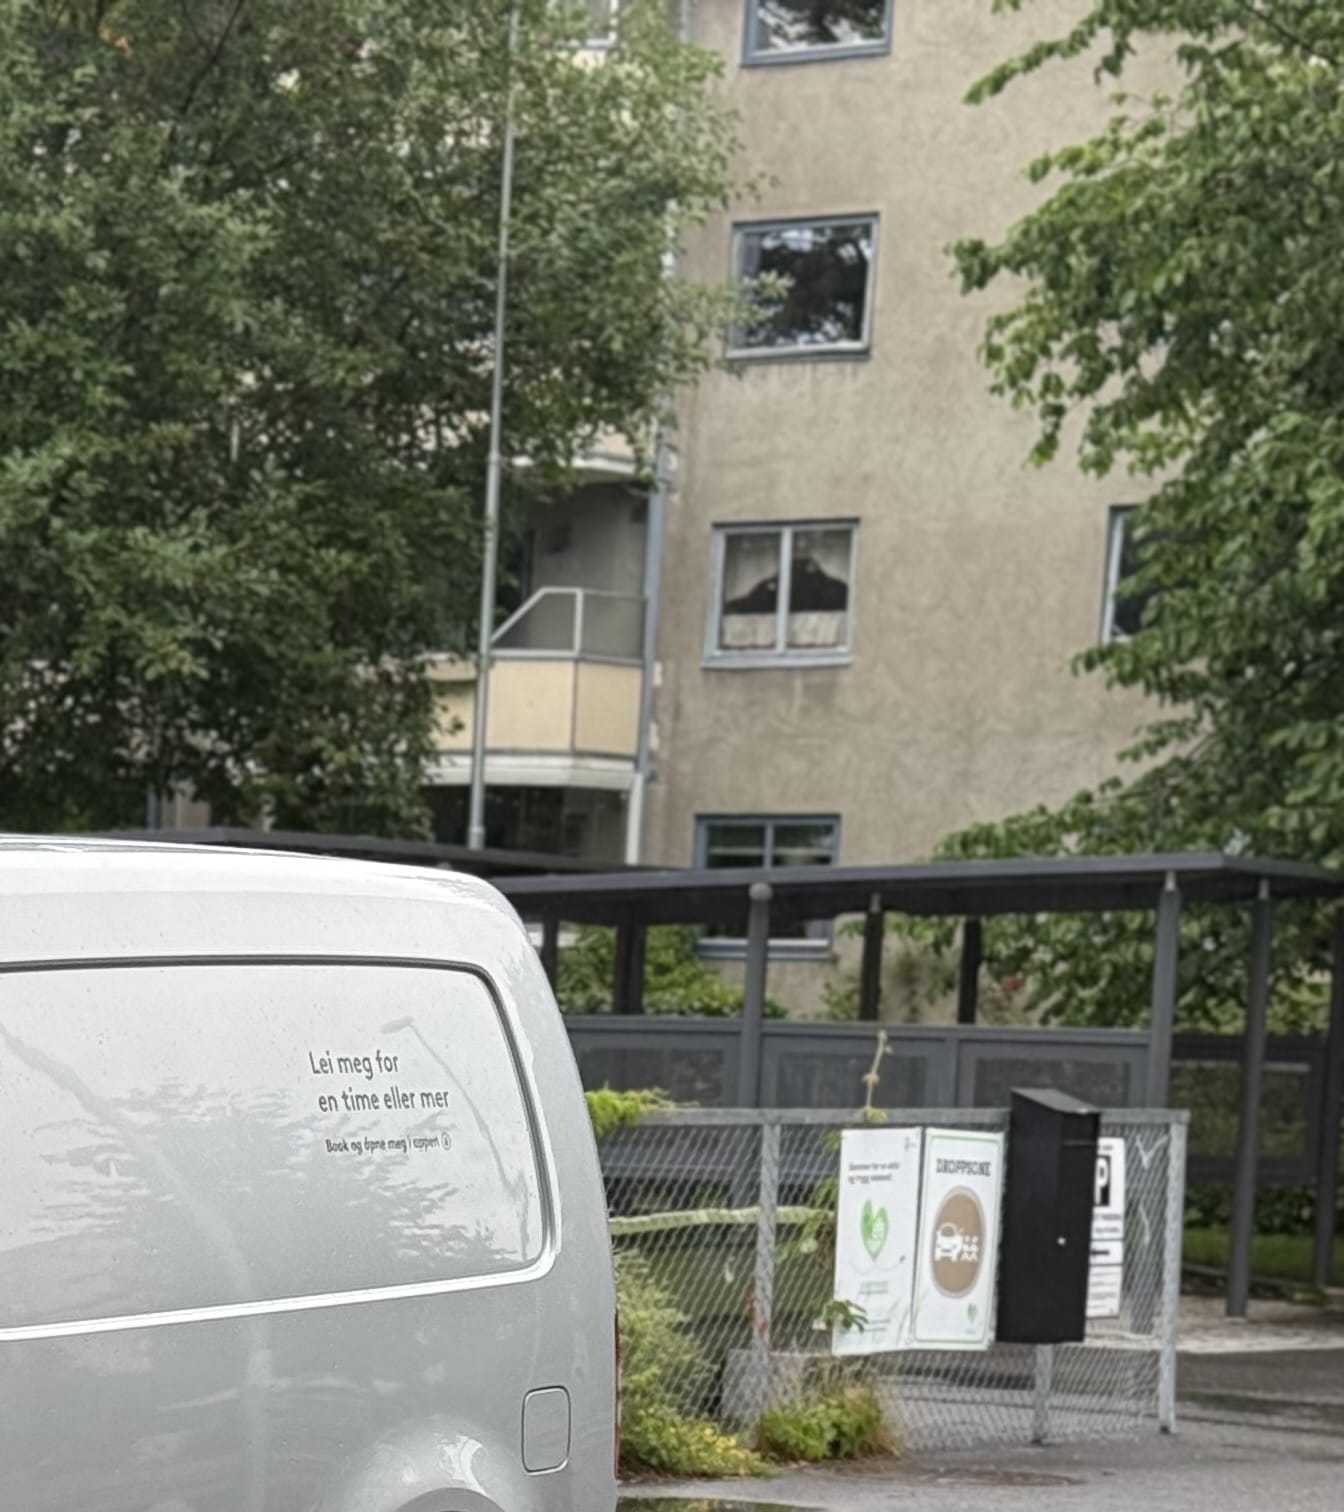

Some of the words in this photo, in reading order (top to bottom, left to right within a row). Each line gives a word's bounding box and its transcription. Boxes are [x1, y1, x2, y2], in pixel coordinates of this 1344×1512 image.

[309, 1050, 334, 1075] Lei
[337, 1055, 374, 1080] meg
[375, 1049, 399, 1073] for
[318, 1094, 339, 1112] en
[341, 1087, 379, 1112] time
[384, 1085, 416, 1110] eller
[419, 1091, 449, 1109] mer
[325, 1138, 349, 1153] Book
[351, 1140, 362, 1156] og
[387, 1138, 407, 1154] meg
[936, 1158, 991, 1176] DROPPSONE
[1095, 1157, 1109, 1206] P
